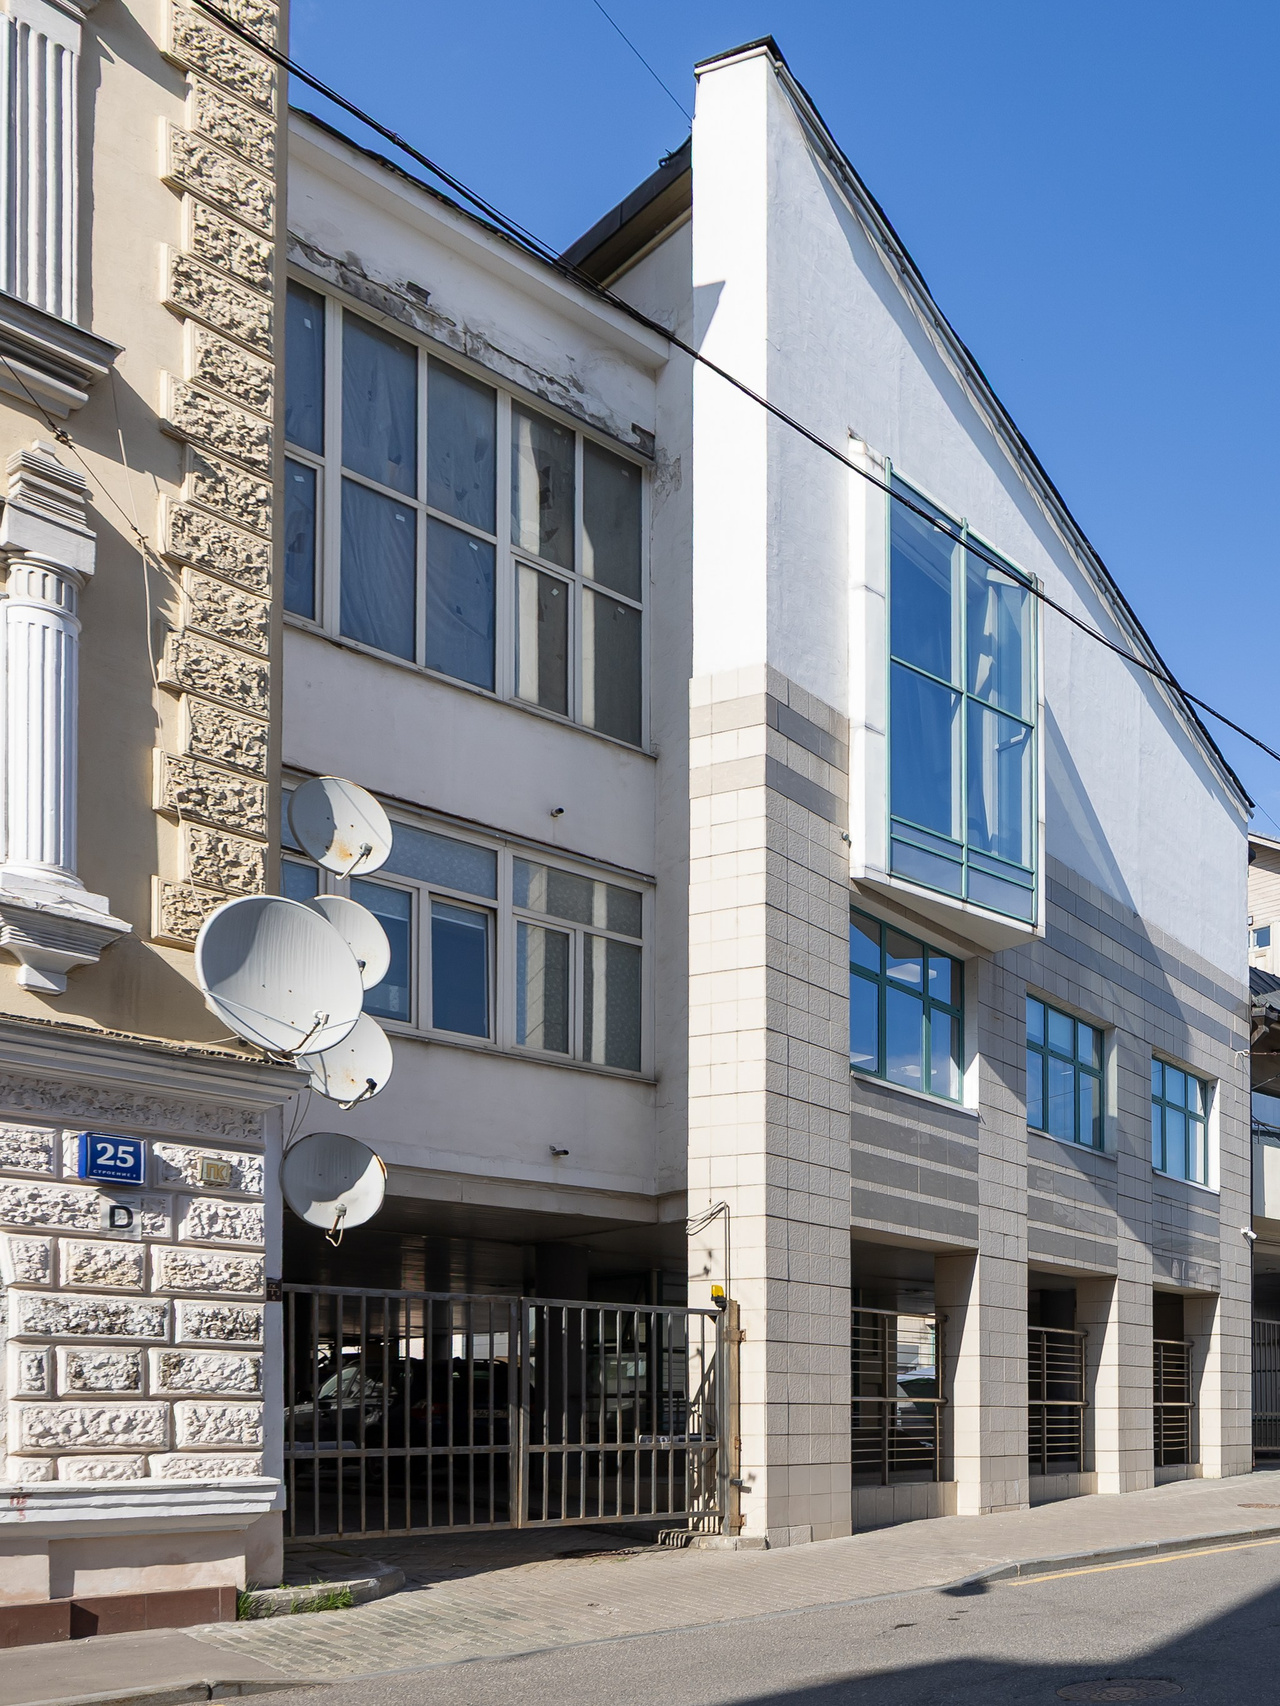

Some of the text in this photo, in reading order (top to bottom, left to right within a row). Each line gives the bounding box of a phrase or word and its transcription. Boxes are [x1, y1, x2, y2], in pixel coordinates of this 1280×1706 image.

[96, 1142, 135, 1168] 25
[92, 1169, 131, 1178] СТРОЕНИЕ
[206, 1162, 226, 1180] ПК
[109, 1204, 134, 1228] D
